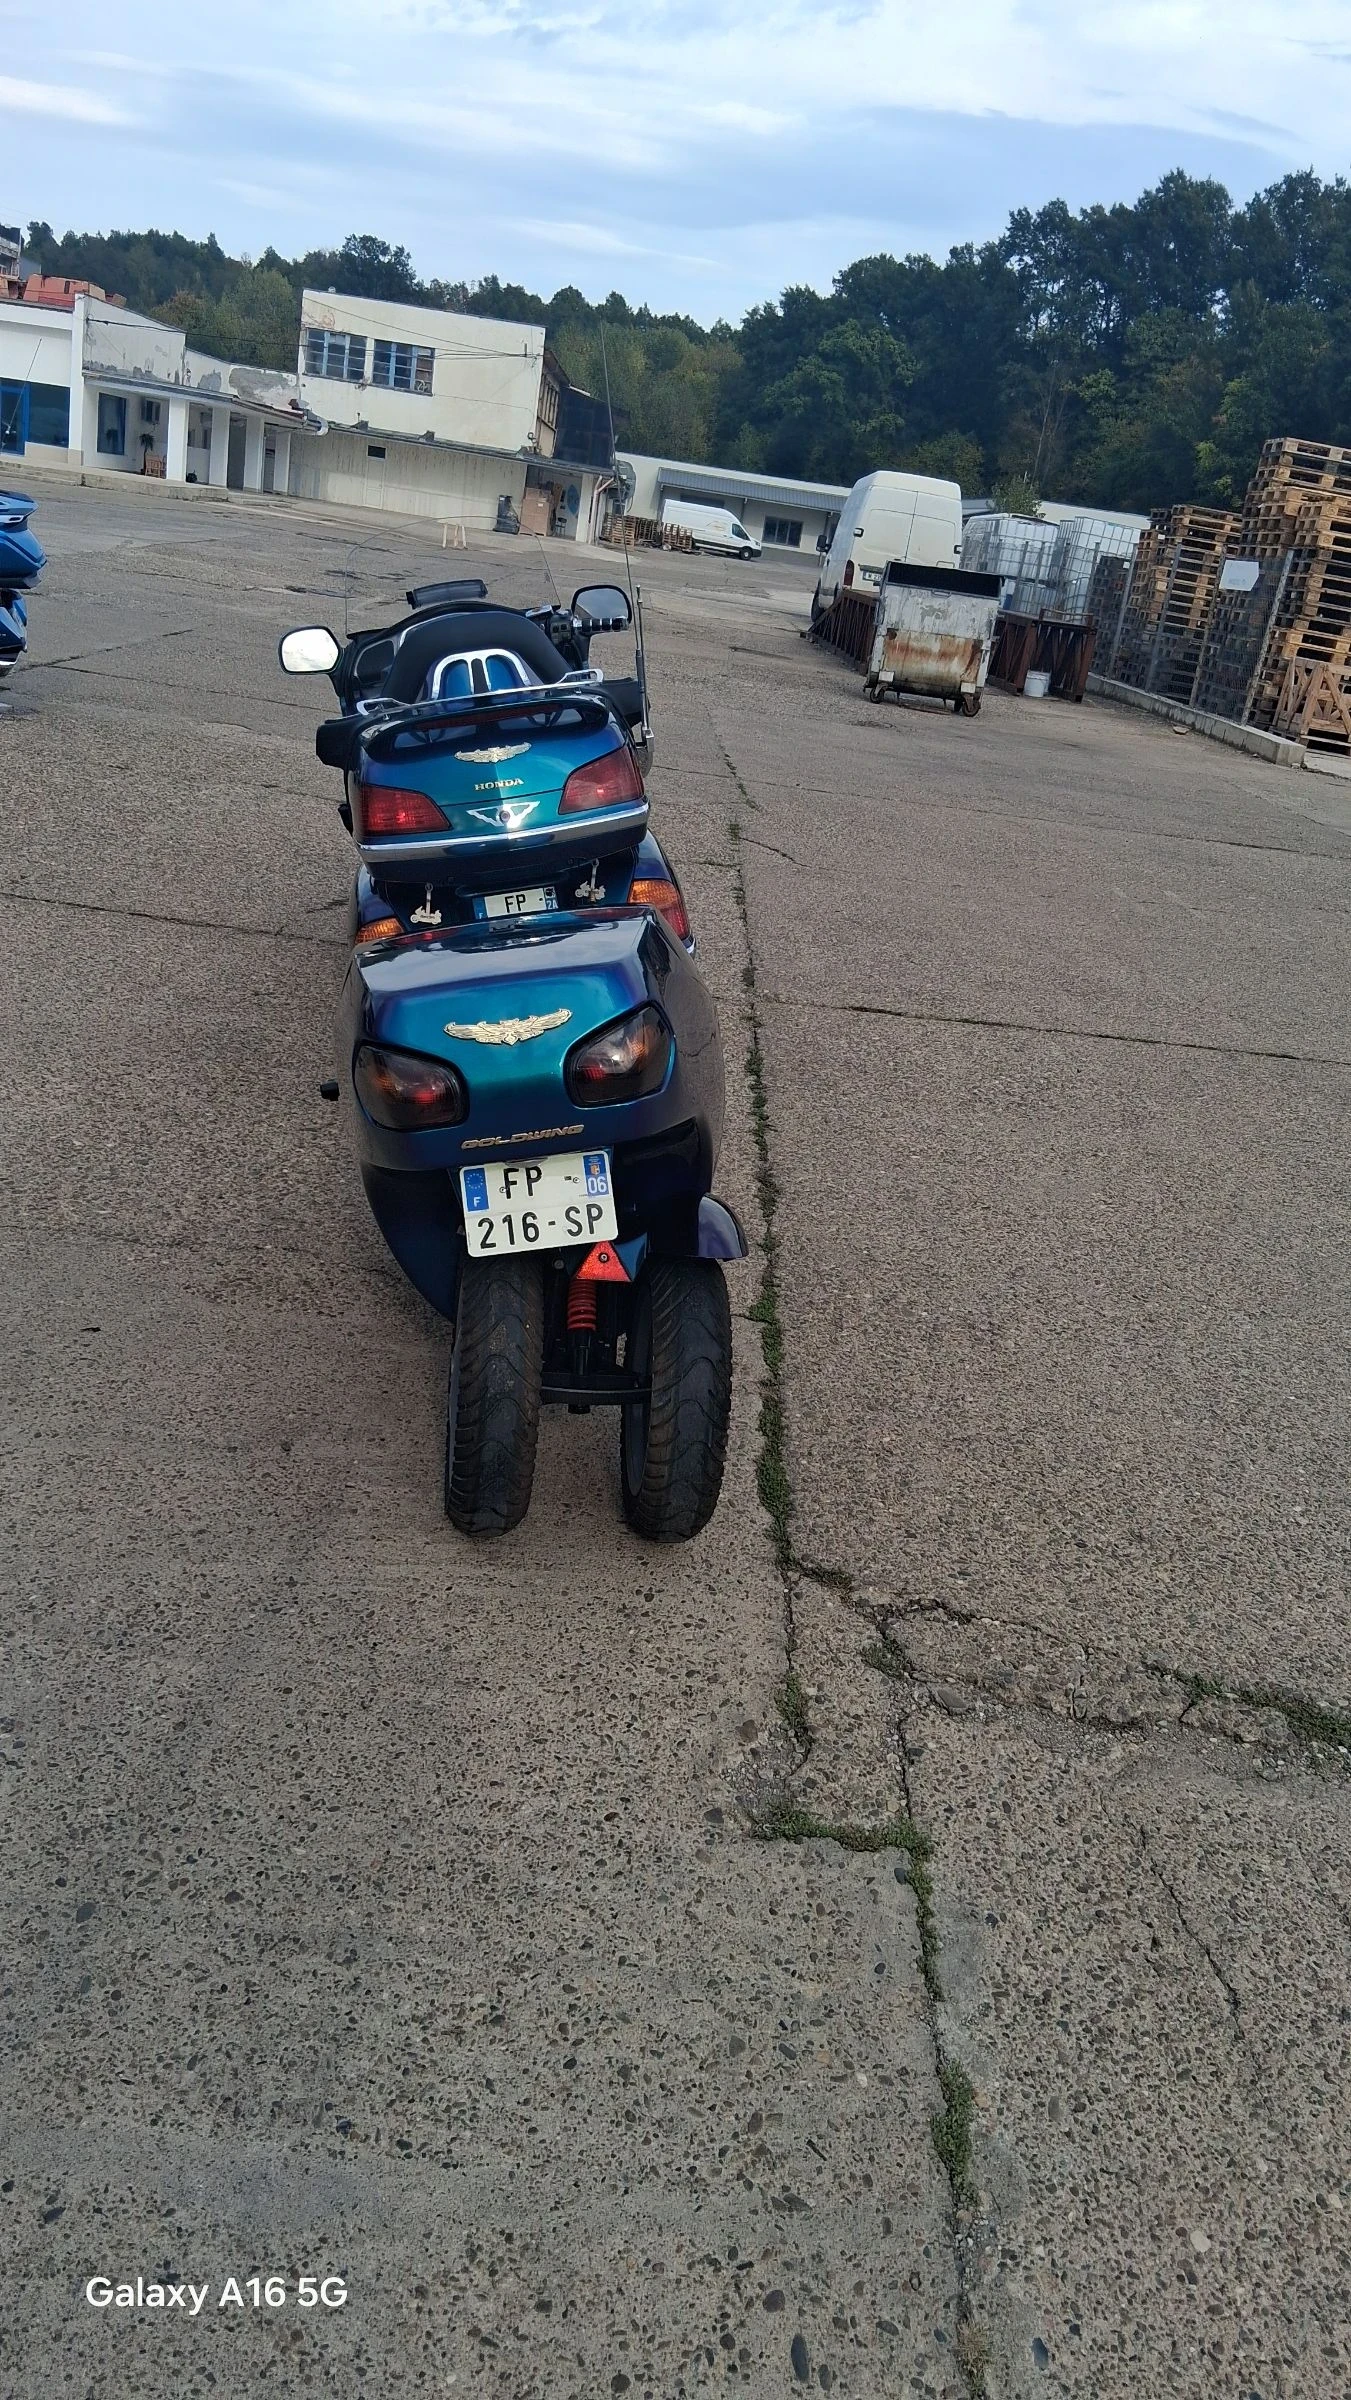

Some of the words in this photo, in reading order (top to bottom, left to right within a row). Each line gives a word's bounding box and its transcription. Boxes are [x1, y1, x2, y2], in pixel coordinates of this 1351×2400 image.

[474, 778, 524, 791] HONDA
[504, 893, 526, 913] FP
[546, 900, 559, 910] 2A
[461, 1124, 584, 1149] GOLDWING
[503, 1165, 543, 1200] FP
[587, 1176, 608, 1194] 06
[473, 1196, 481, 1208] F
